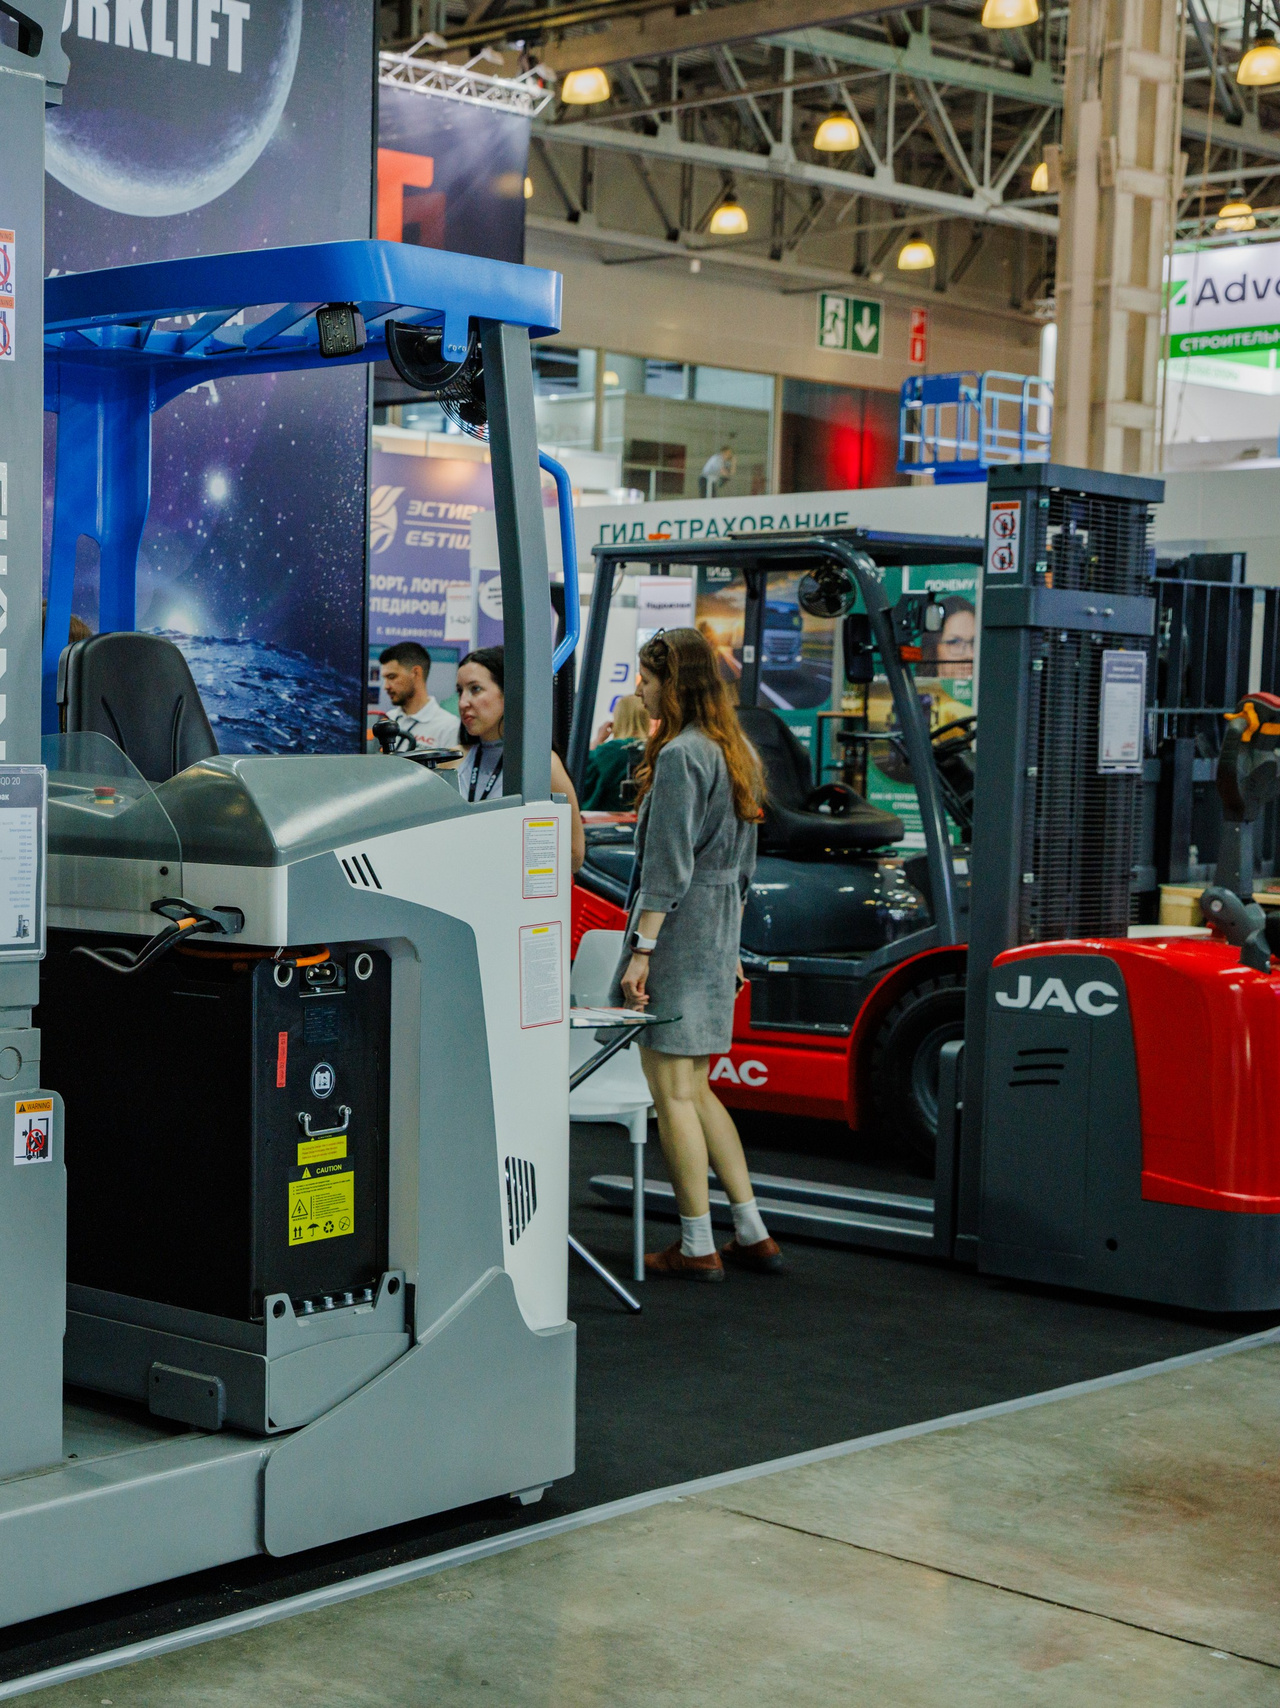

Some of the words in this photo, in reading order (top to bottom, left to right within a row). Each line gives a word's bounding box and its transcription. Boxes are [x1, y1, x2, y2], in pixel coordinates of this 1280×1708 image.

[62, 0, 250, 73] RKLIFT
[406, 500, 486, 521] ЭСТИВ
[599, 522, 645, 545] ГИД
[414, 733, 435, 745] AC
[12, 777, 20, 786] 20
[995, 974, 1119, 1016] JAC
[709, 1056, 768, 1087] AC
[26, 1101, 51, 1110] WARNING
[316, 1163, 343, 1175] CAUTION
